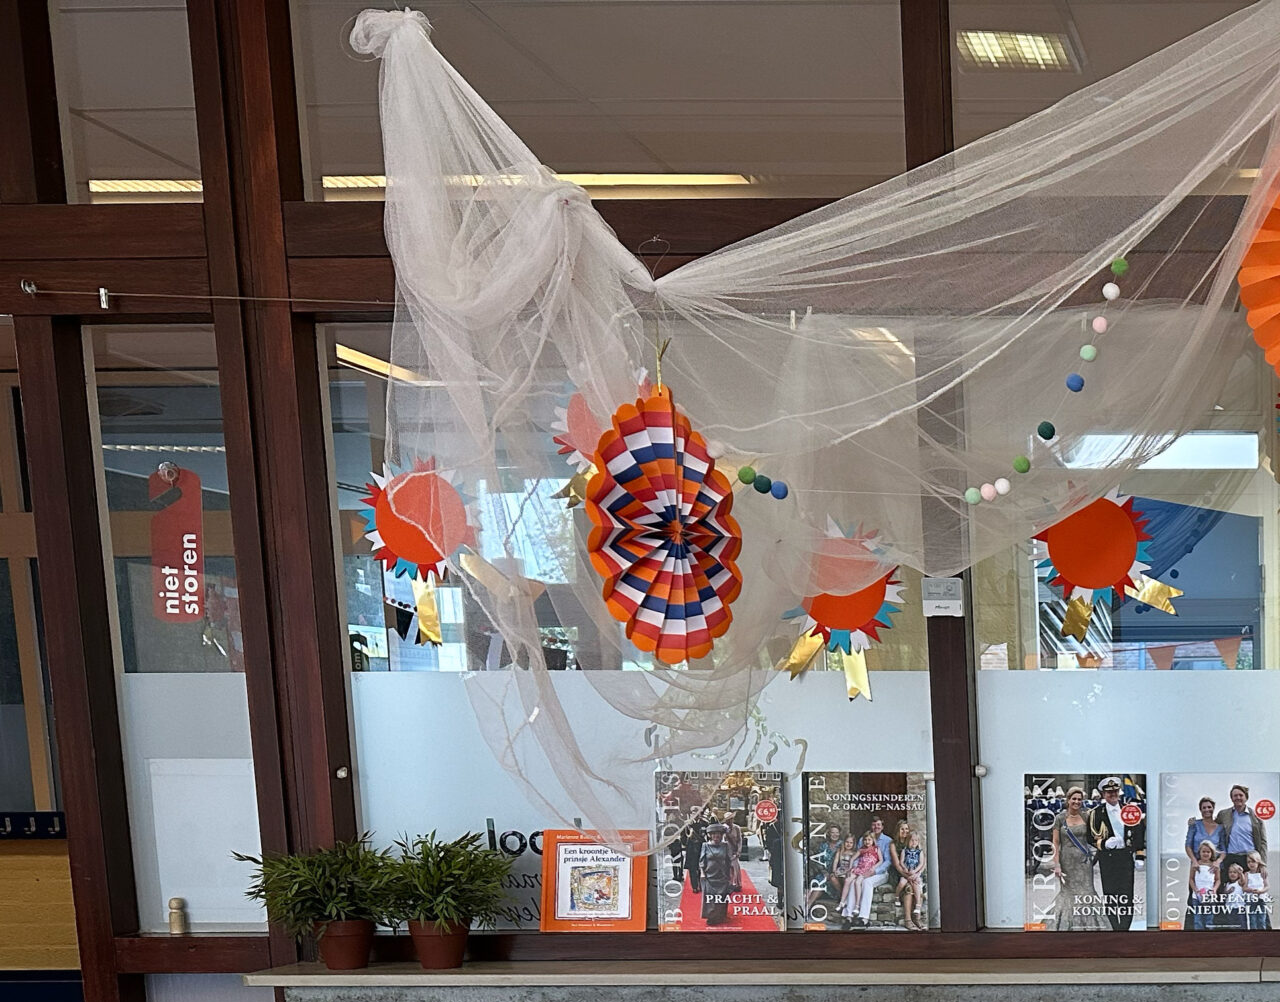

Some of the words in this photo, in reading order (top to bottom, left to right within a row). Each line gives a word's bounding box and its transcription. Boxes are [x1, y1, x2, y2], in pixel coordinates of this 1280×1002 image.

[182, 533, 199, 615] storen
[159, 565, 179, 614] niet
[826, 793, 925, 802] KONINGSKINDEREN
[832, 803, 841, 811] &
[843, 802, 925, 812] ORANJE-NASSAU
[808, 775, 832, 922] ORANJE
[1032, 776, 1056, 921] KROON
[1165, 775, 1180, 921] OPVOGING
[706, 894, 763, 905] PRACHT
[767, 894, 778, 904] &
[1074, 894, 1128, 904] KONING
[1132, 894, 1144, 904] &
[1202, 893, 1259, 903] ERFENIS
[1263, 893, 1274, 903] &
[733, 906, 779, 916] PRAAL
[1072, 906, 1143, 916] KONINGIN
[1186, 905, 1234, 915] NIEUW
[1238, 905, 1274, 915] ELAN
